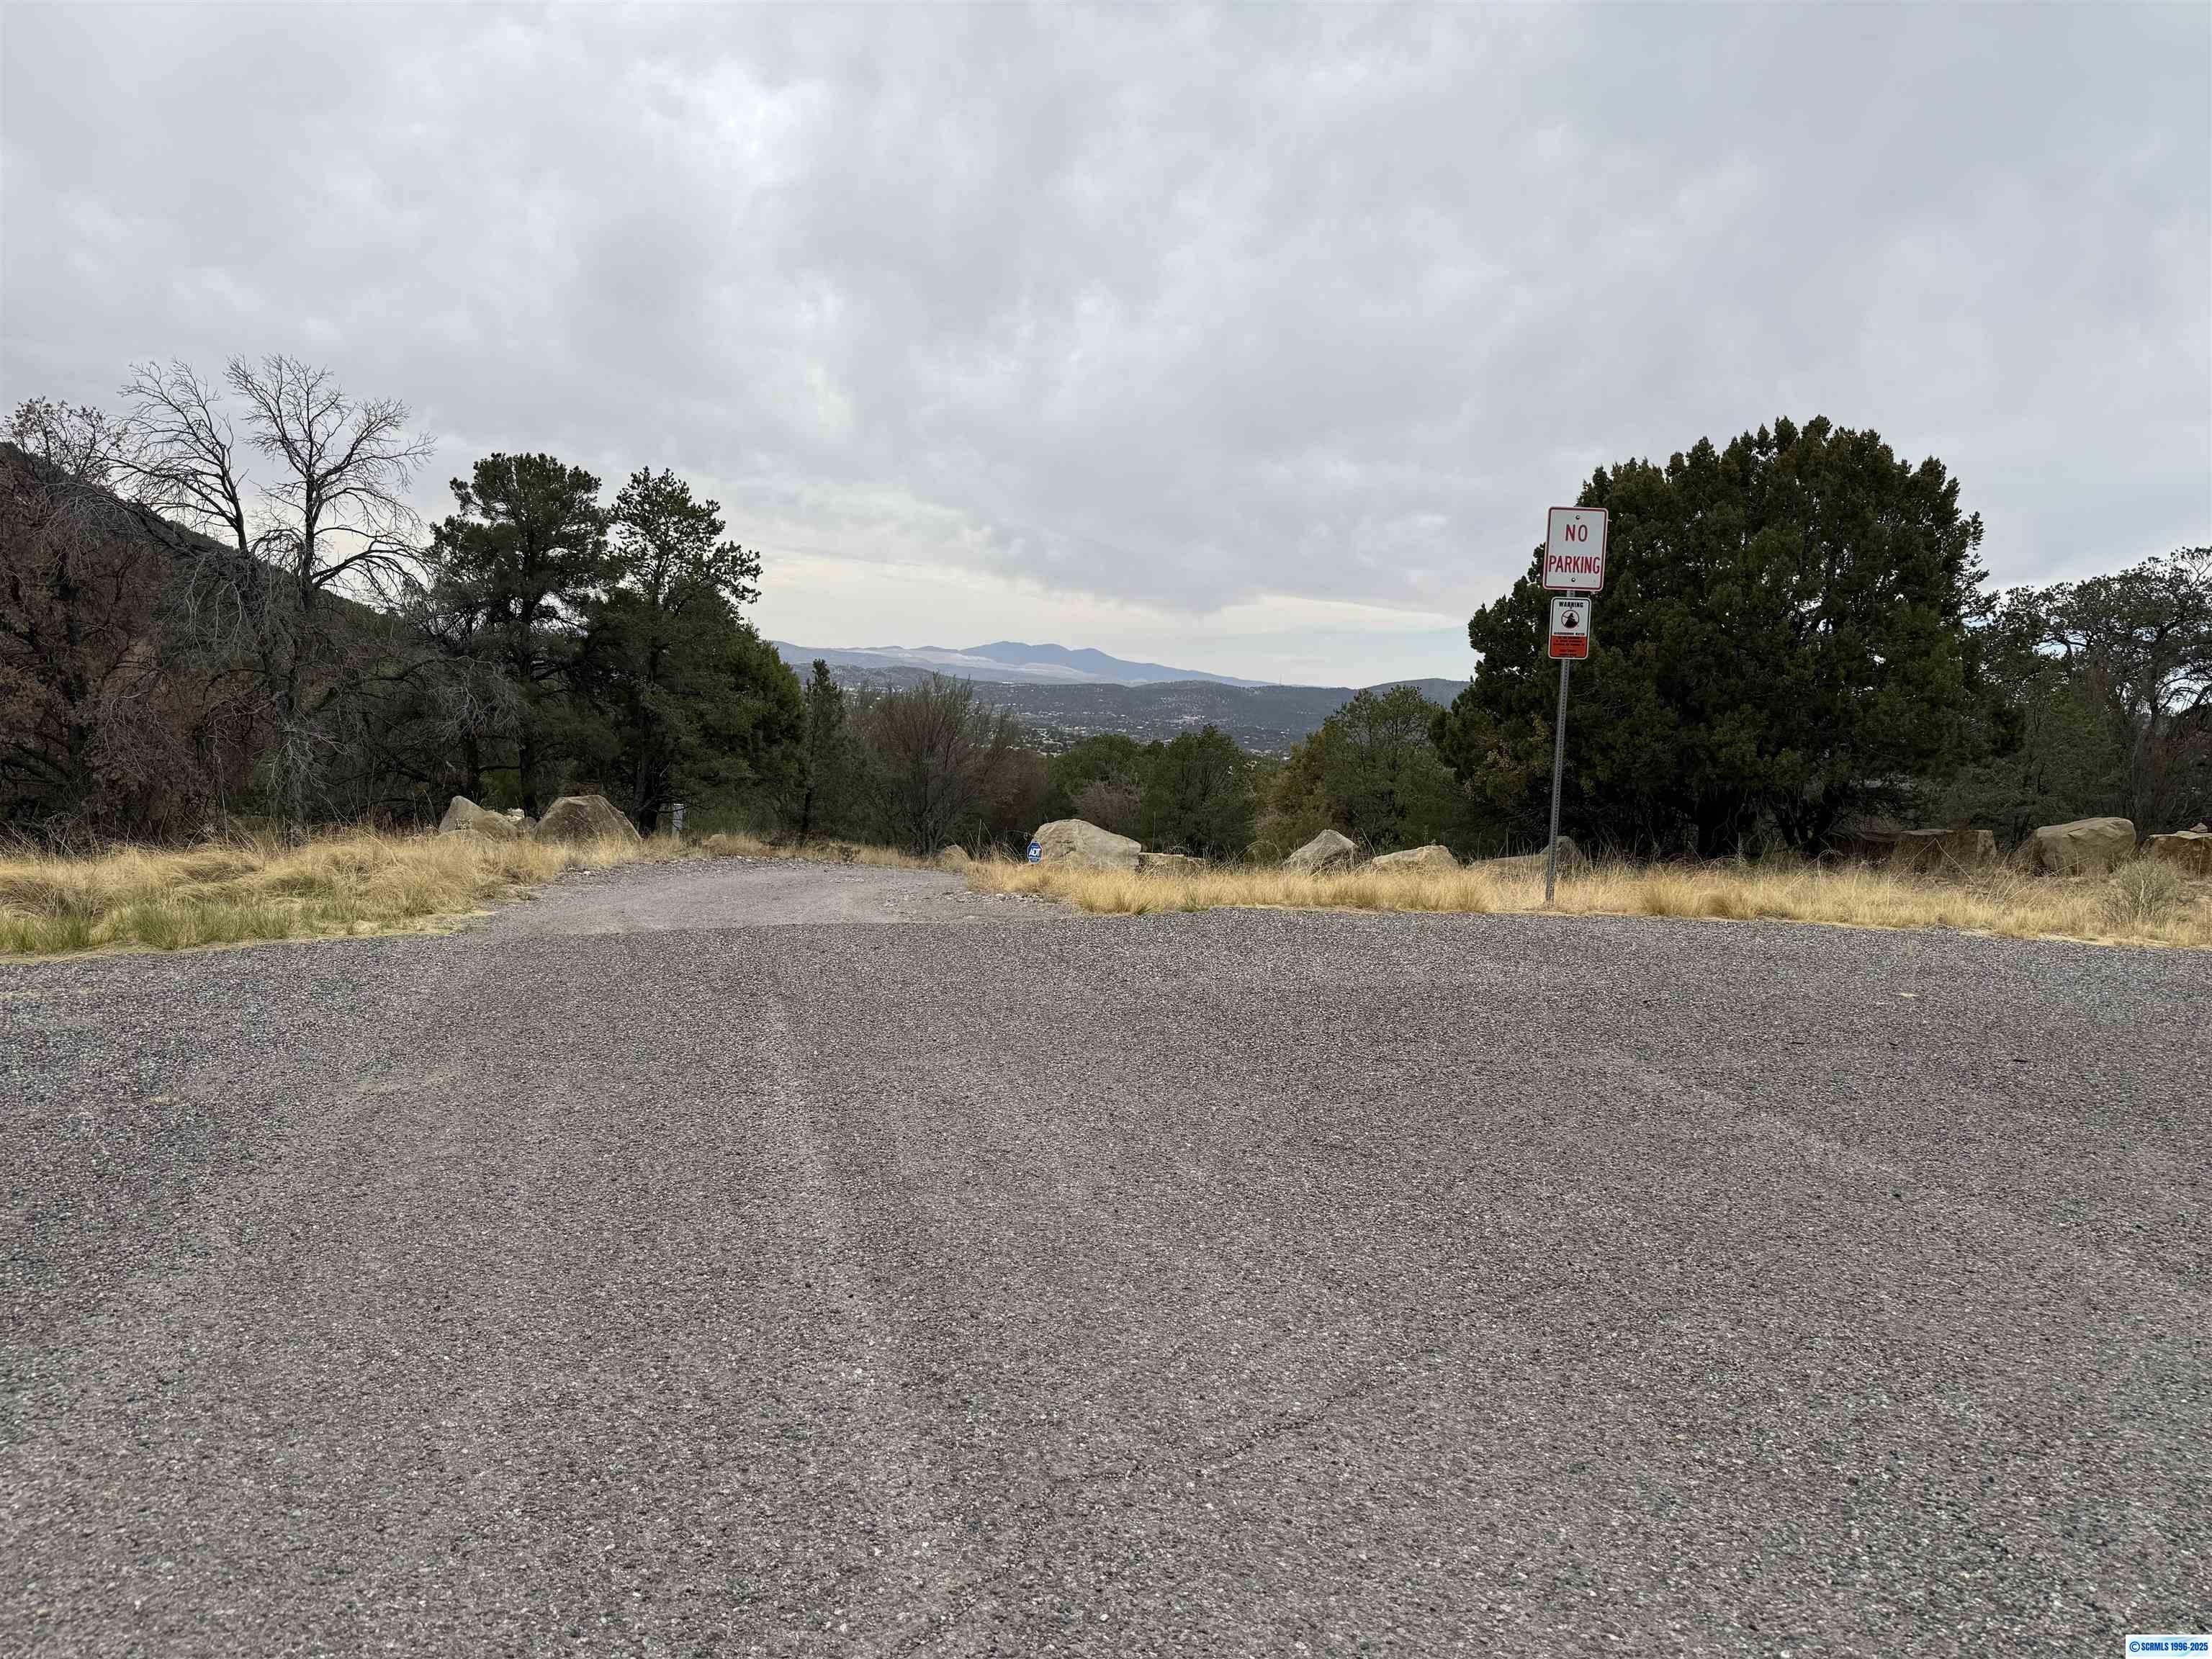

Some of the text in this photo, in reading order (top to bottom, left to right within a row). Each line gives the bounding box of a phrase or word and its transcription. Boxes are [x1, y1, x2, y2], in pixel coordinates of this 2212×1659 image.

[1565, 524, 1588, 542] NO
[1549, 556, 1600, 574] PARKING
[1029, 848, 1041, 856] ADT
